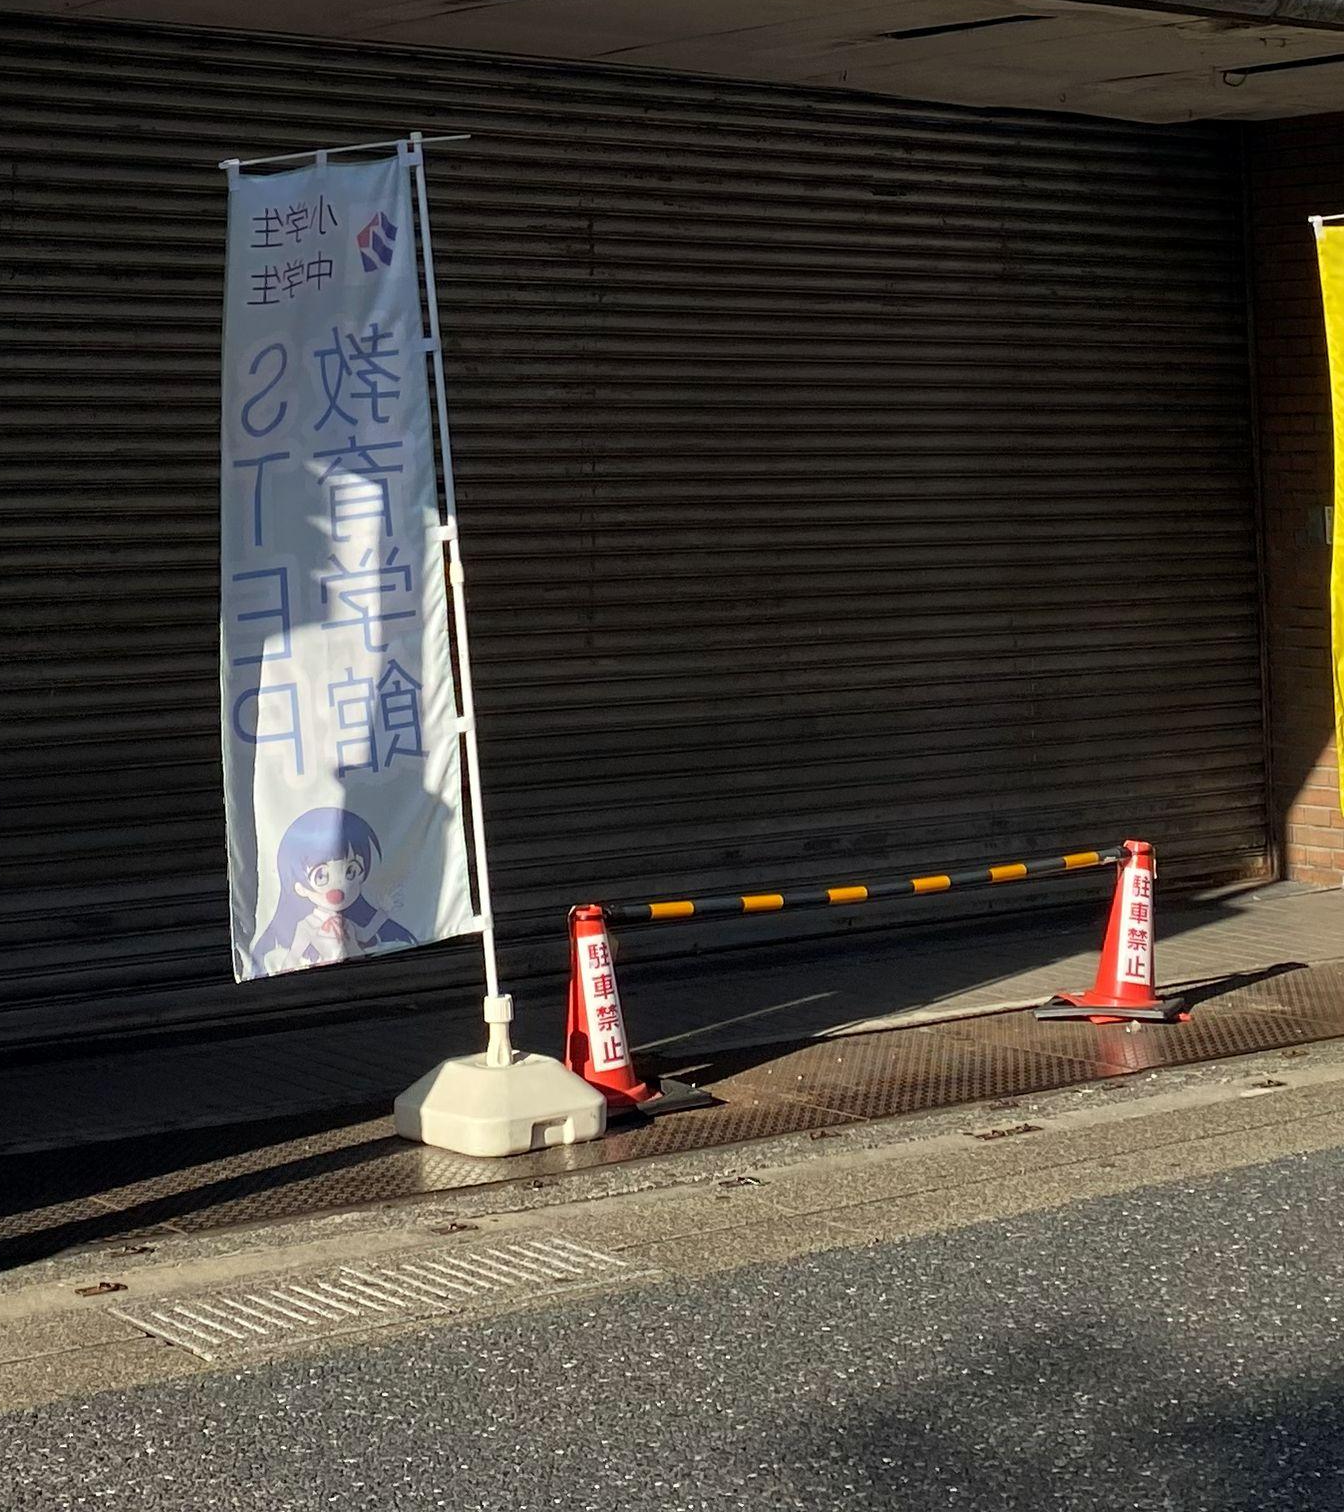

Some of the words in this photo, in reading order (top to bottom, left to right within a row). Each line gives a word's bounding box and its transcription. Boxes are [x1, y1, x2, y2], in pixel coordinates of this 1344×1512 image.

[1125, 874, 1151, 979] 駐車禁止
[587, 941, 625, 1066] 駐車禁止
